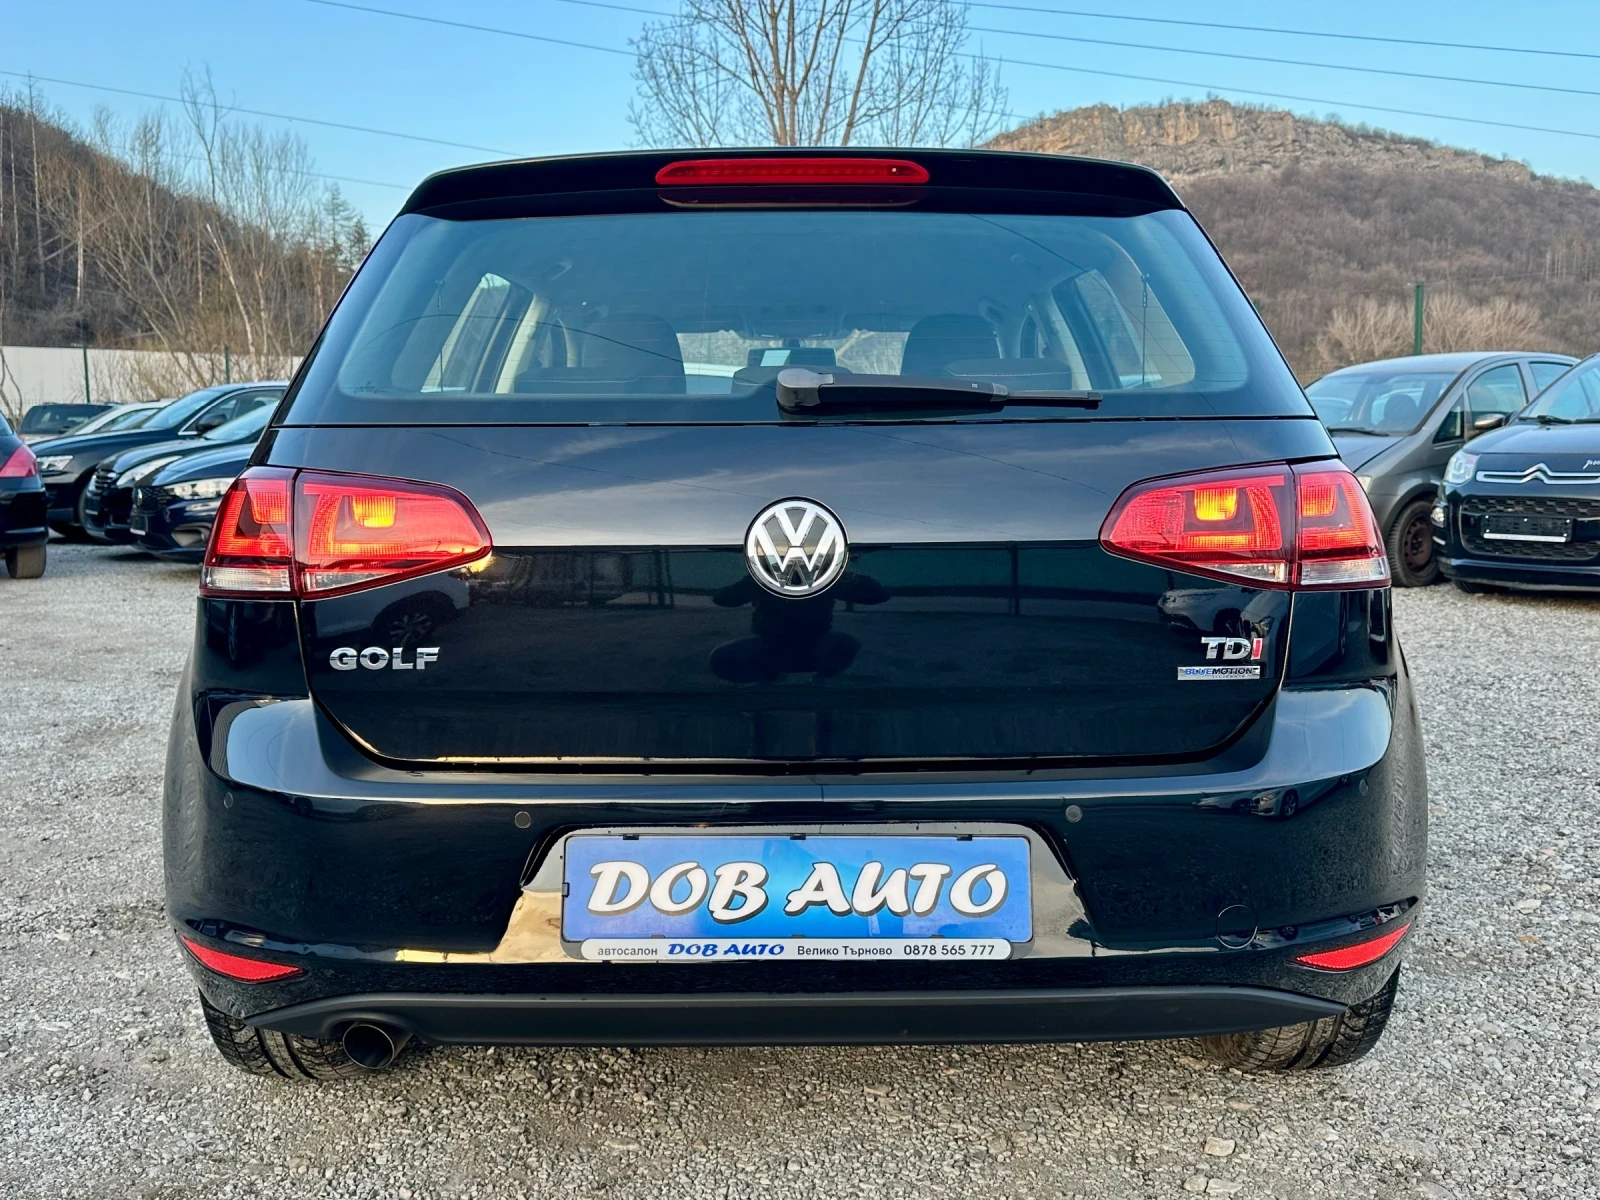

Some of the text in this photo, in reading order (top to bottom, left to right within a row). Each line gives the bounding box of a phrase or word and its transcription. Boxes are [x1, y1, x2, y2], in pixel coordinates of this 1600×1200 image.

[748, 500, 845, 596] VW
[329, 646, 440, 671] GOLF
[1201, 636, 1263, 660] TDI
[587, 860, 1010, 924] DOB AUTO
[597, 943, 995, 957] автосалон DOB AUTO Велико Търново 0878 565 777
